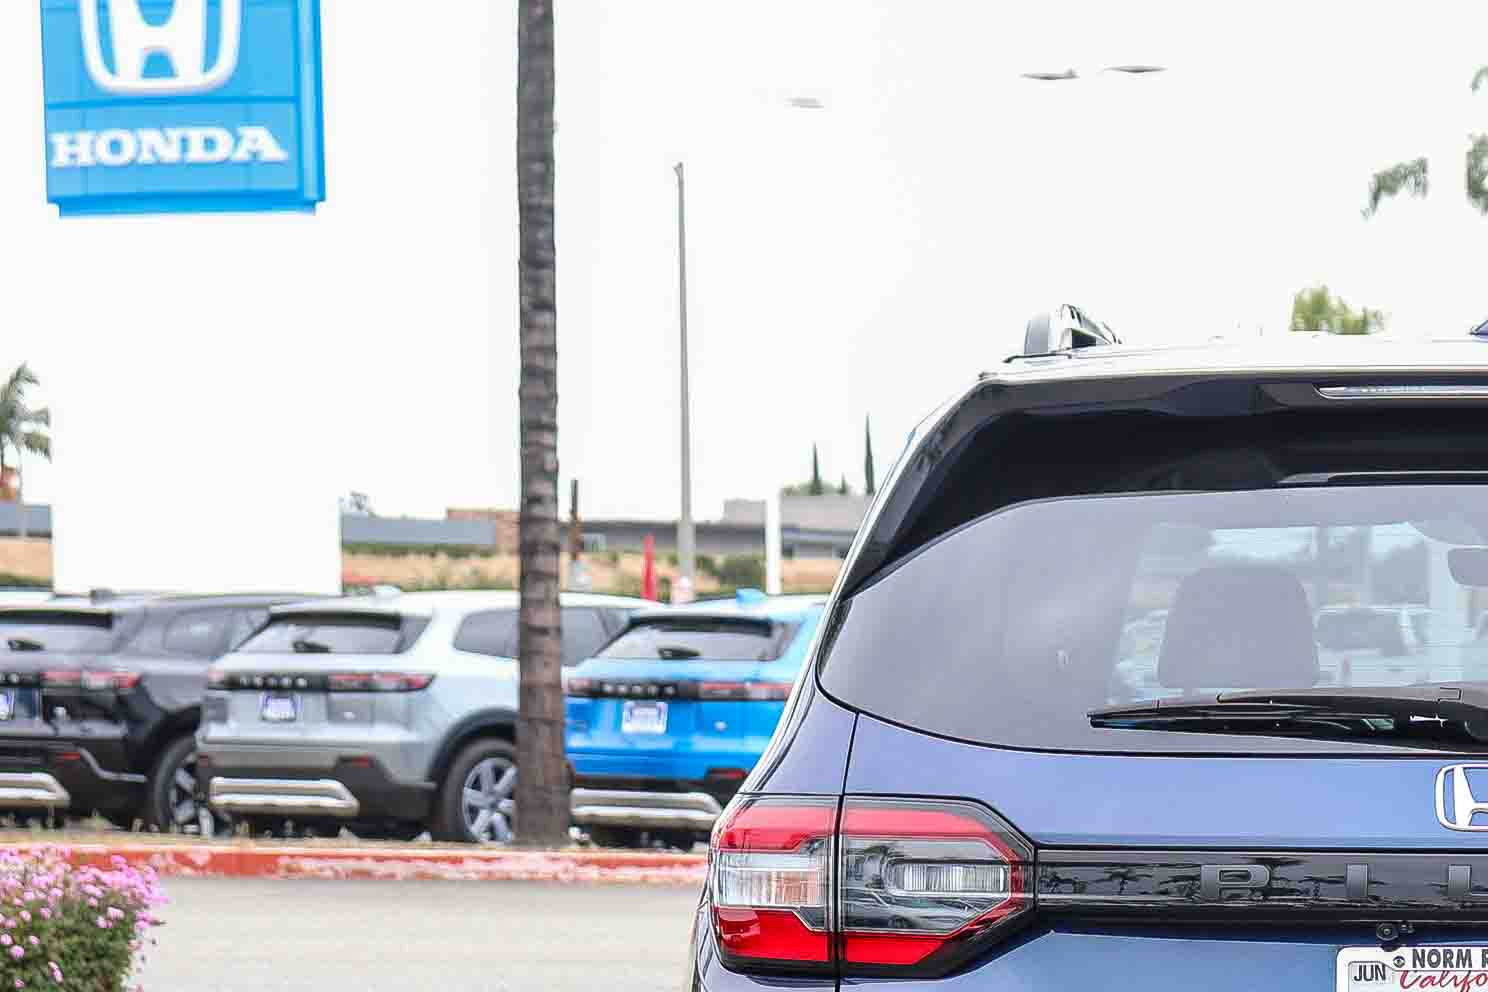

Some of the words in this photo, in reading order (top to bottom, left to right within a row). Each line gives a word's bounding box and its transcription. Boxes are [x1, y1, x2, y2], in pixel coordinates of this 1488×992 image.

[49, 126, 289, 168] HONDA
[1412, 948, 1473, 969] NORM
[1353, 964, 1387, 982] JUN
